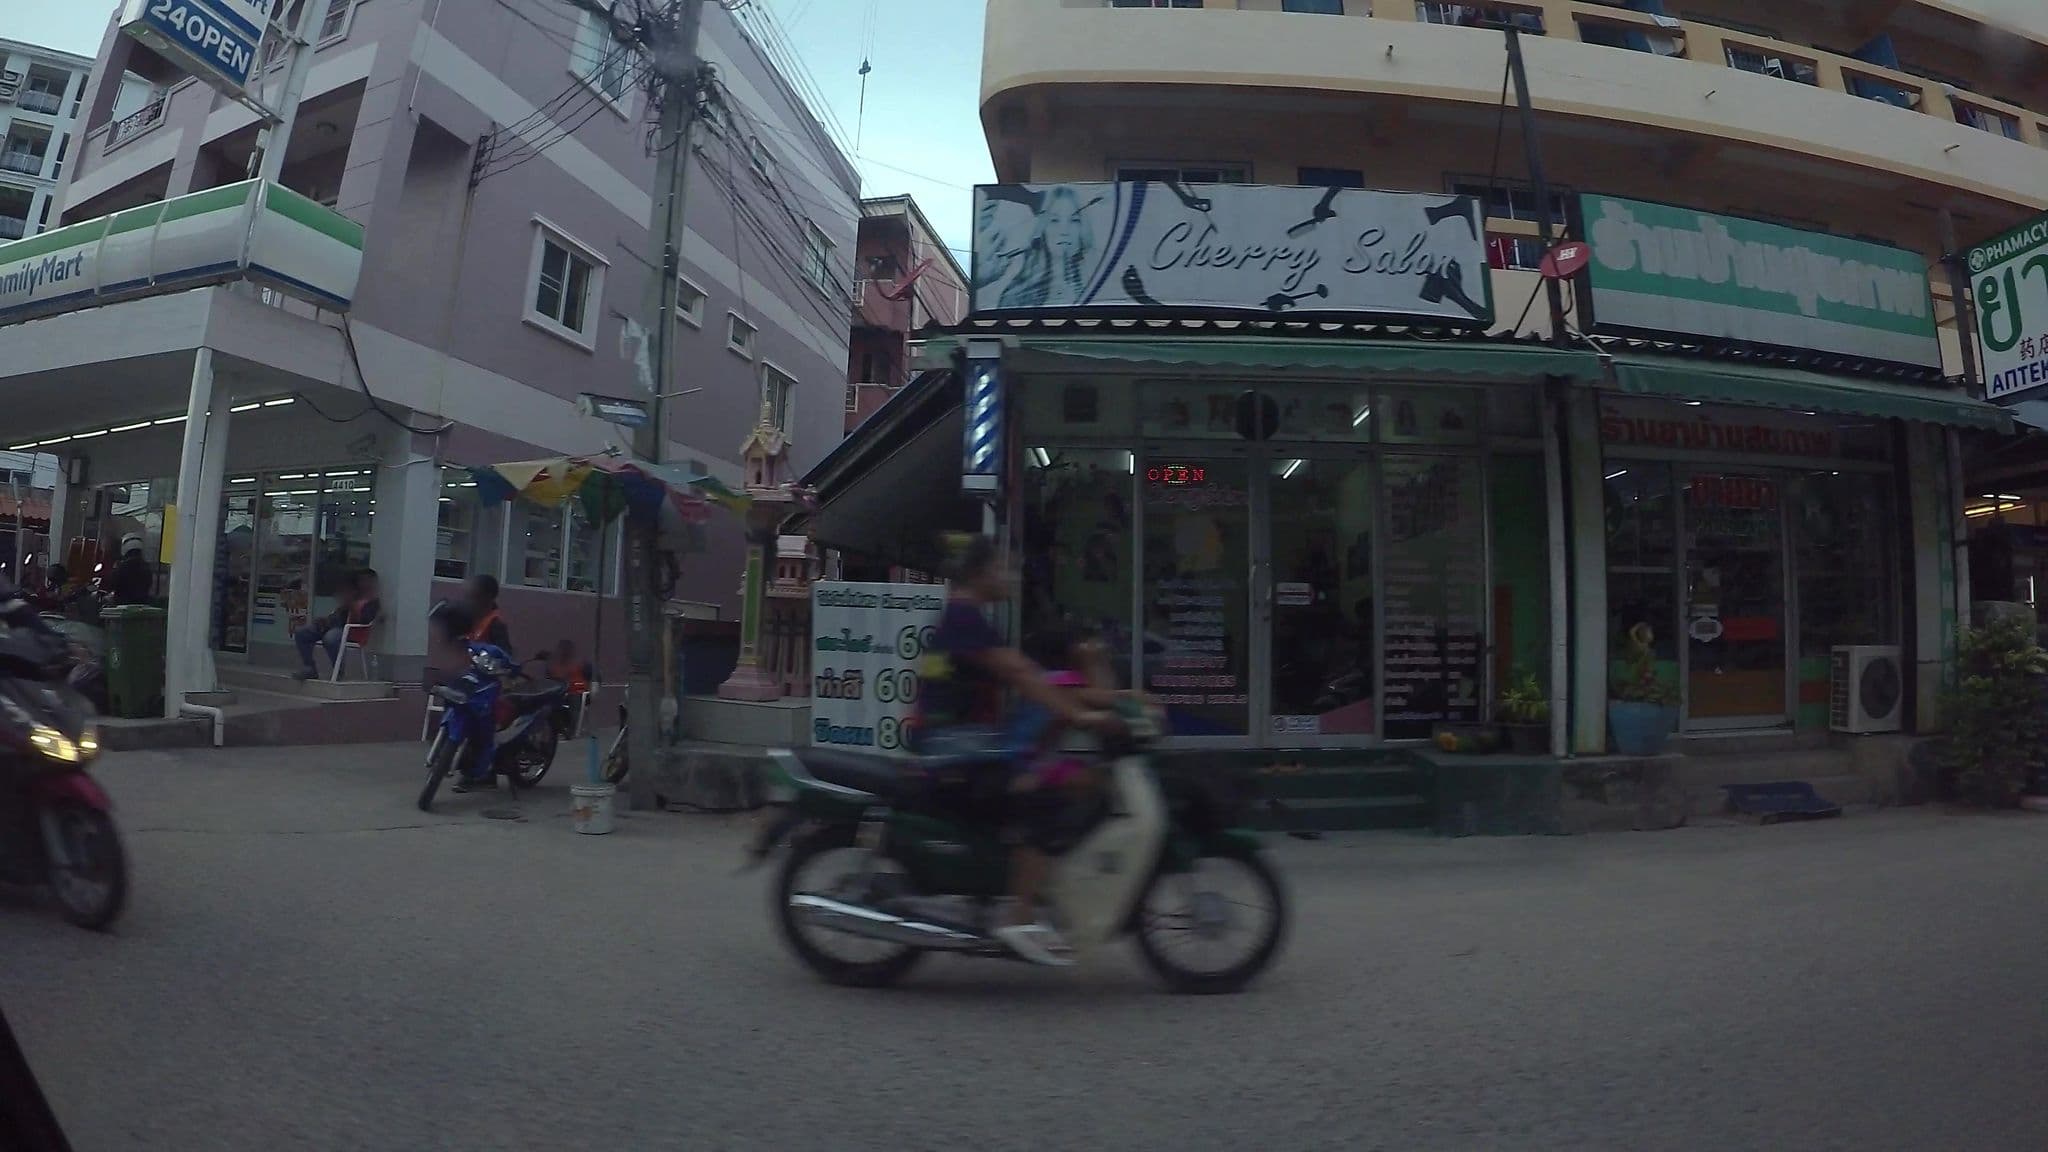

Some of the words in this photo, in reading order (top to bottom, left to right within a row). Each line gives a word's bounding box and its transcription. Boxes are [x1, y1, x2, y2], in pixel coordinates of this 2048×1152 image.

[1150, 221, 1321, 292] Cherry
[1342, 226, 1457, 280] Salon
[1986, 220, 2048, 263] PHAMACY
[0, 250, 84, 296] milyMart
[1146, 468, 1206, 481] OPEN
[876, 667, 919, 704] 60
